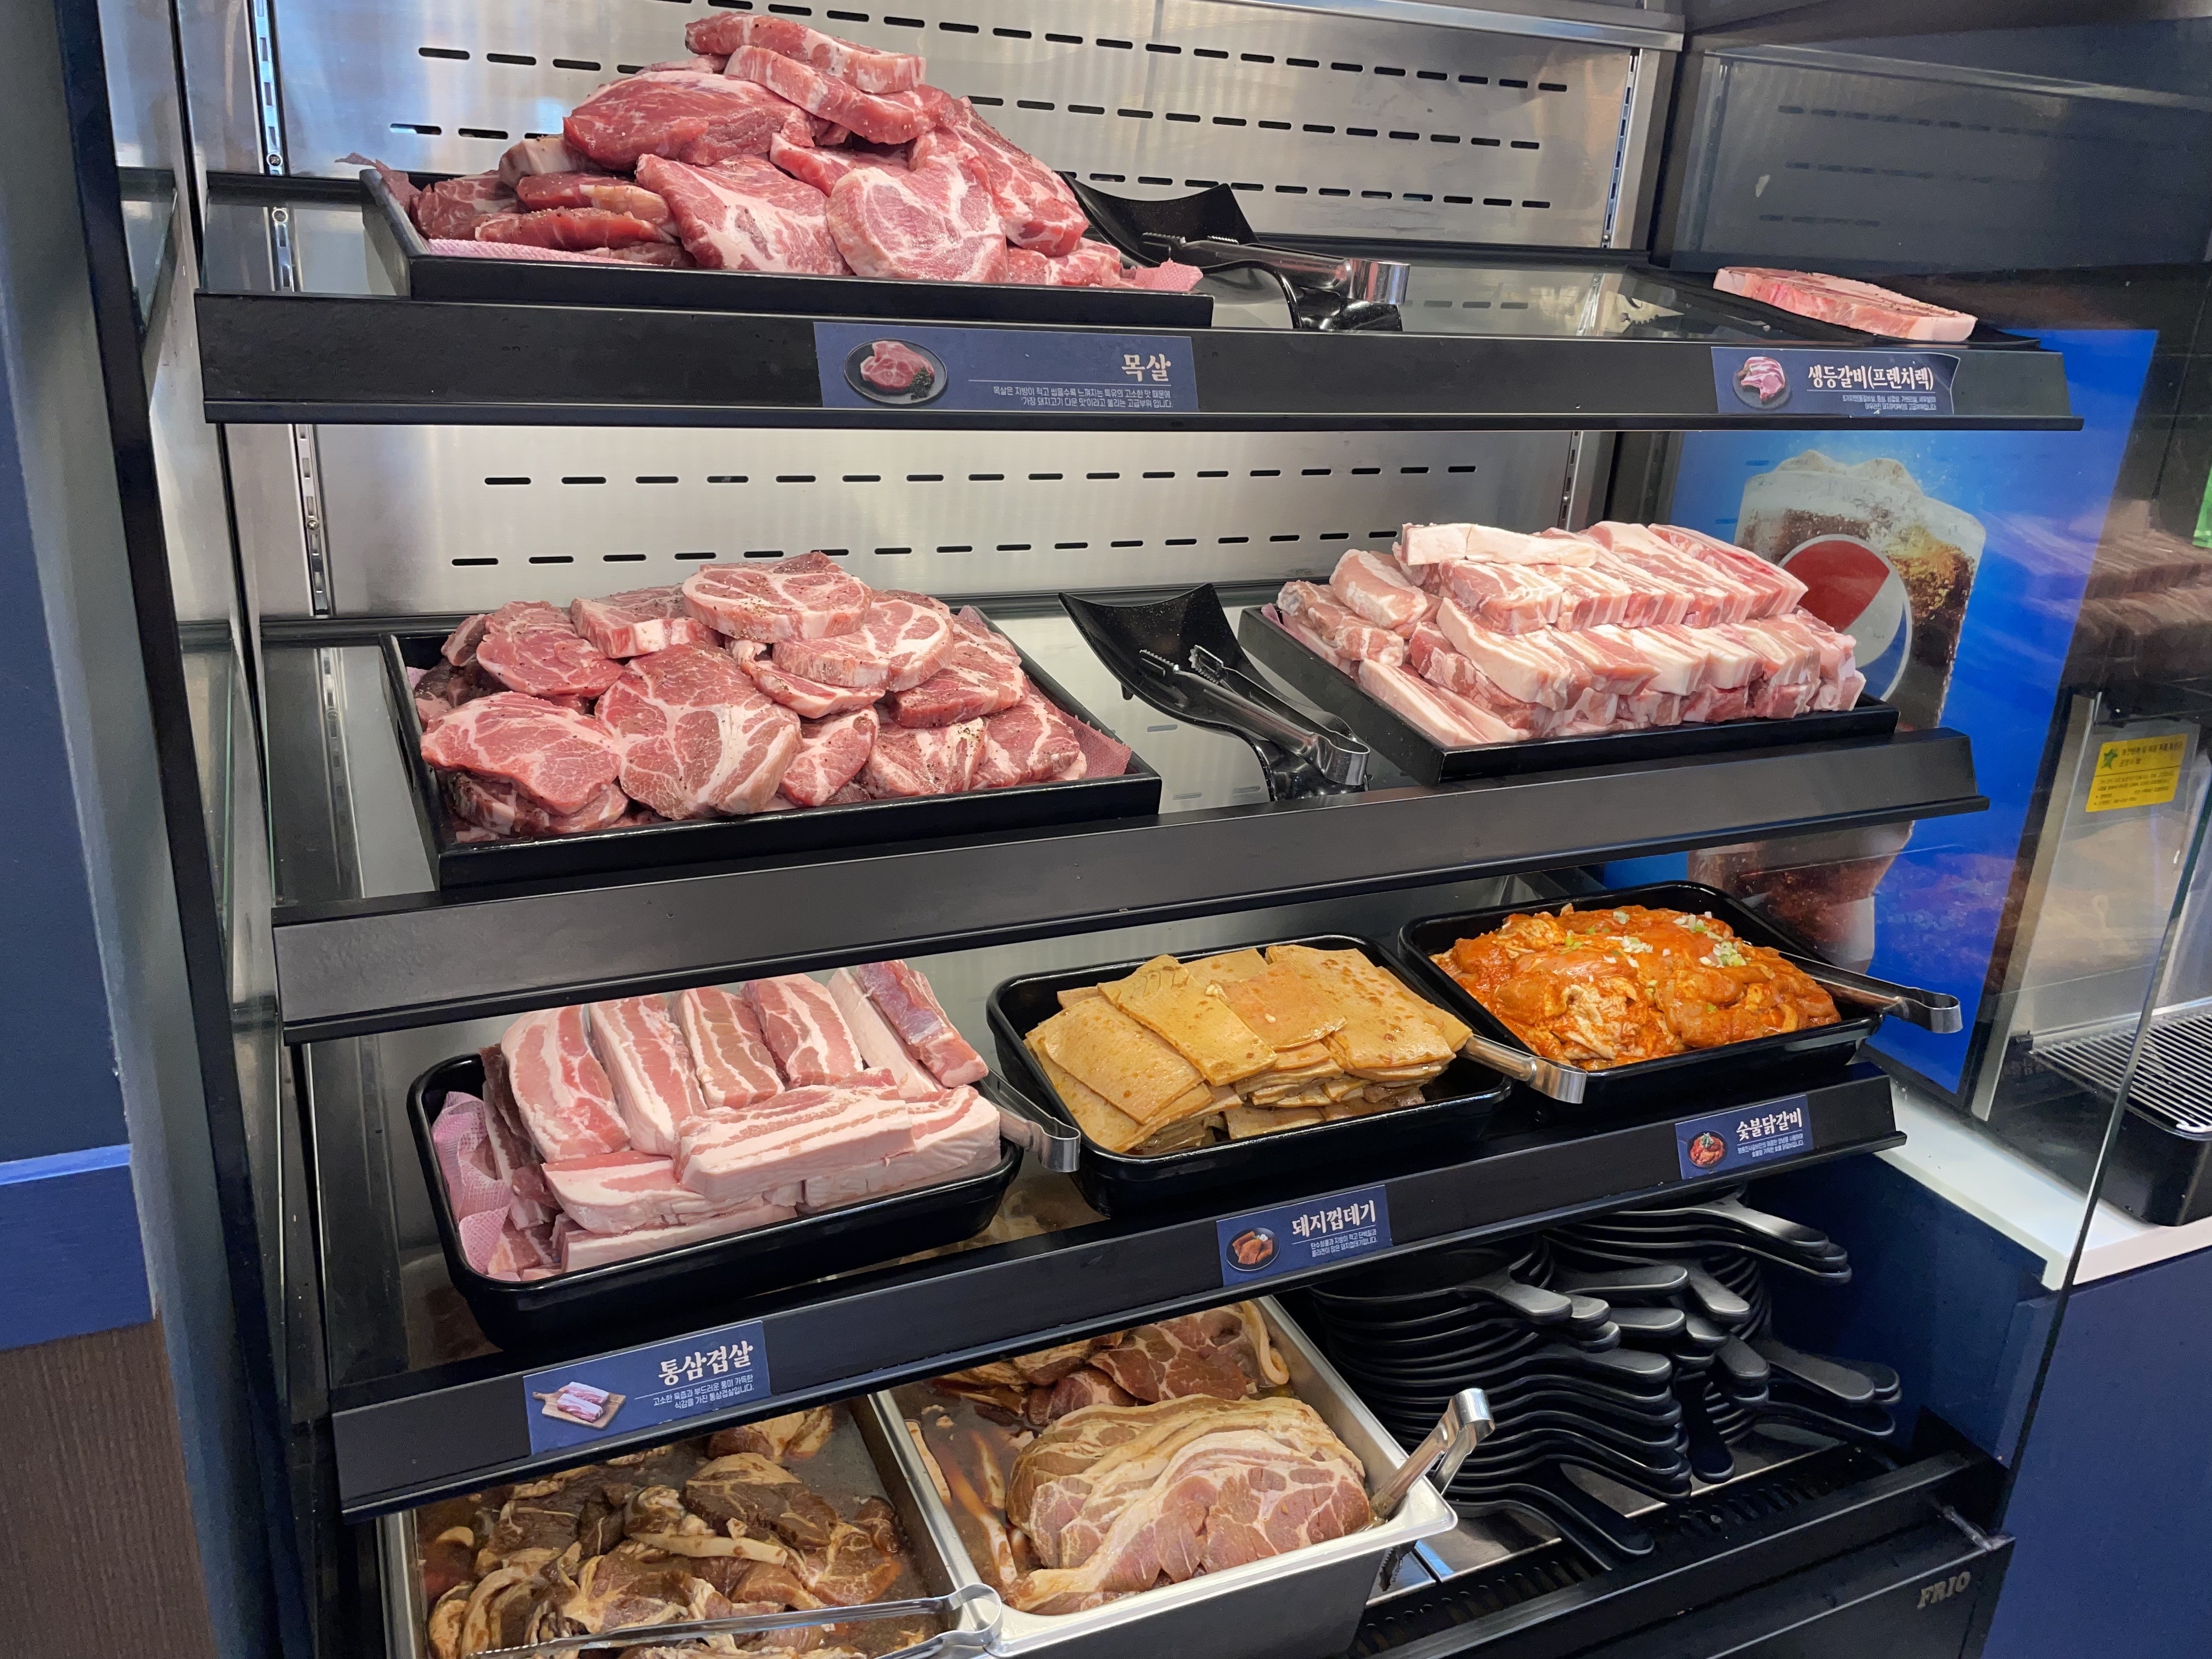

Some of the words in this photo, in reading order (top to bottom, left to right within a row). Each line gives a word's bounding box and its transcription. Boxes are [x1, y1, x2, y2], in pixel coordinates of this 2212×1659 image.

[1121, 354, 1172, 382] 목살
[993, 386, 1013, 396] 목살은
[1015, 387, 1035, 396] 지방이
[1036, 387, 1049, 396] 적고
[1104, 388, 1124, 398] 특유의
[1125, 389, 1143, 398] 고소한
[1144, 390, 1151, 399] 맛
[1152, 390, 1171, 399] 때문에
[1037, 397, 1063, 406] 돼지고기
[1065, 398, 1078, 407] 다운
[1107, 398, 1126, 408] 불리는
[1127, 399, 1152, 408] 고급부위
[1153, 399, 1173, 408] 입니다.
[1736, 1108, 1802, 1142] 숯불닭갈비
[1291, 1200, 1376, 1237] 돼지껍데기
[1334, 1235, 1348, 1244] 지방이
[658, 1340, 754, 1386] 통삼겹살
[653, 1395, 673, 1406] 고소한
[674, 1389, 693, 1400] 육즙과
[695, 1383, 720, 1395] 부드러운
[721, 1378, 733, 1389] 풍미
[735, 1374, 754, 1385] 가득한
[674, 1398, 694, 1409] 식감을
[696, 1395, 708, 1404] 가진
[709, 1383, 755, 1402] 통삼겹살입니다.
[1917, 1571, 1971, 1610] FRIO
